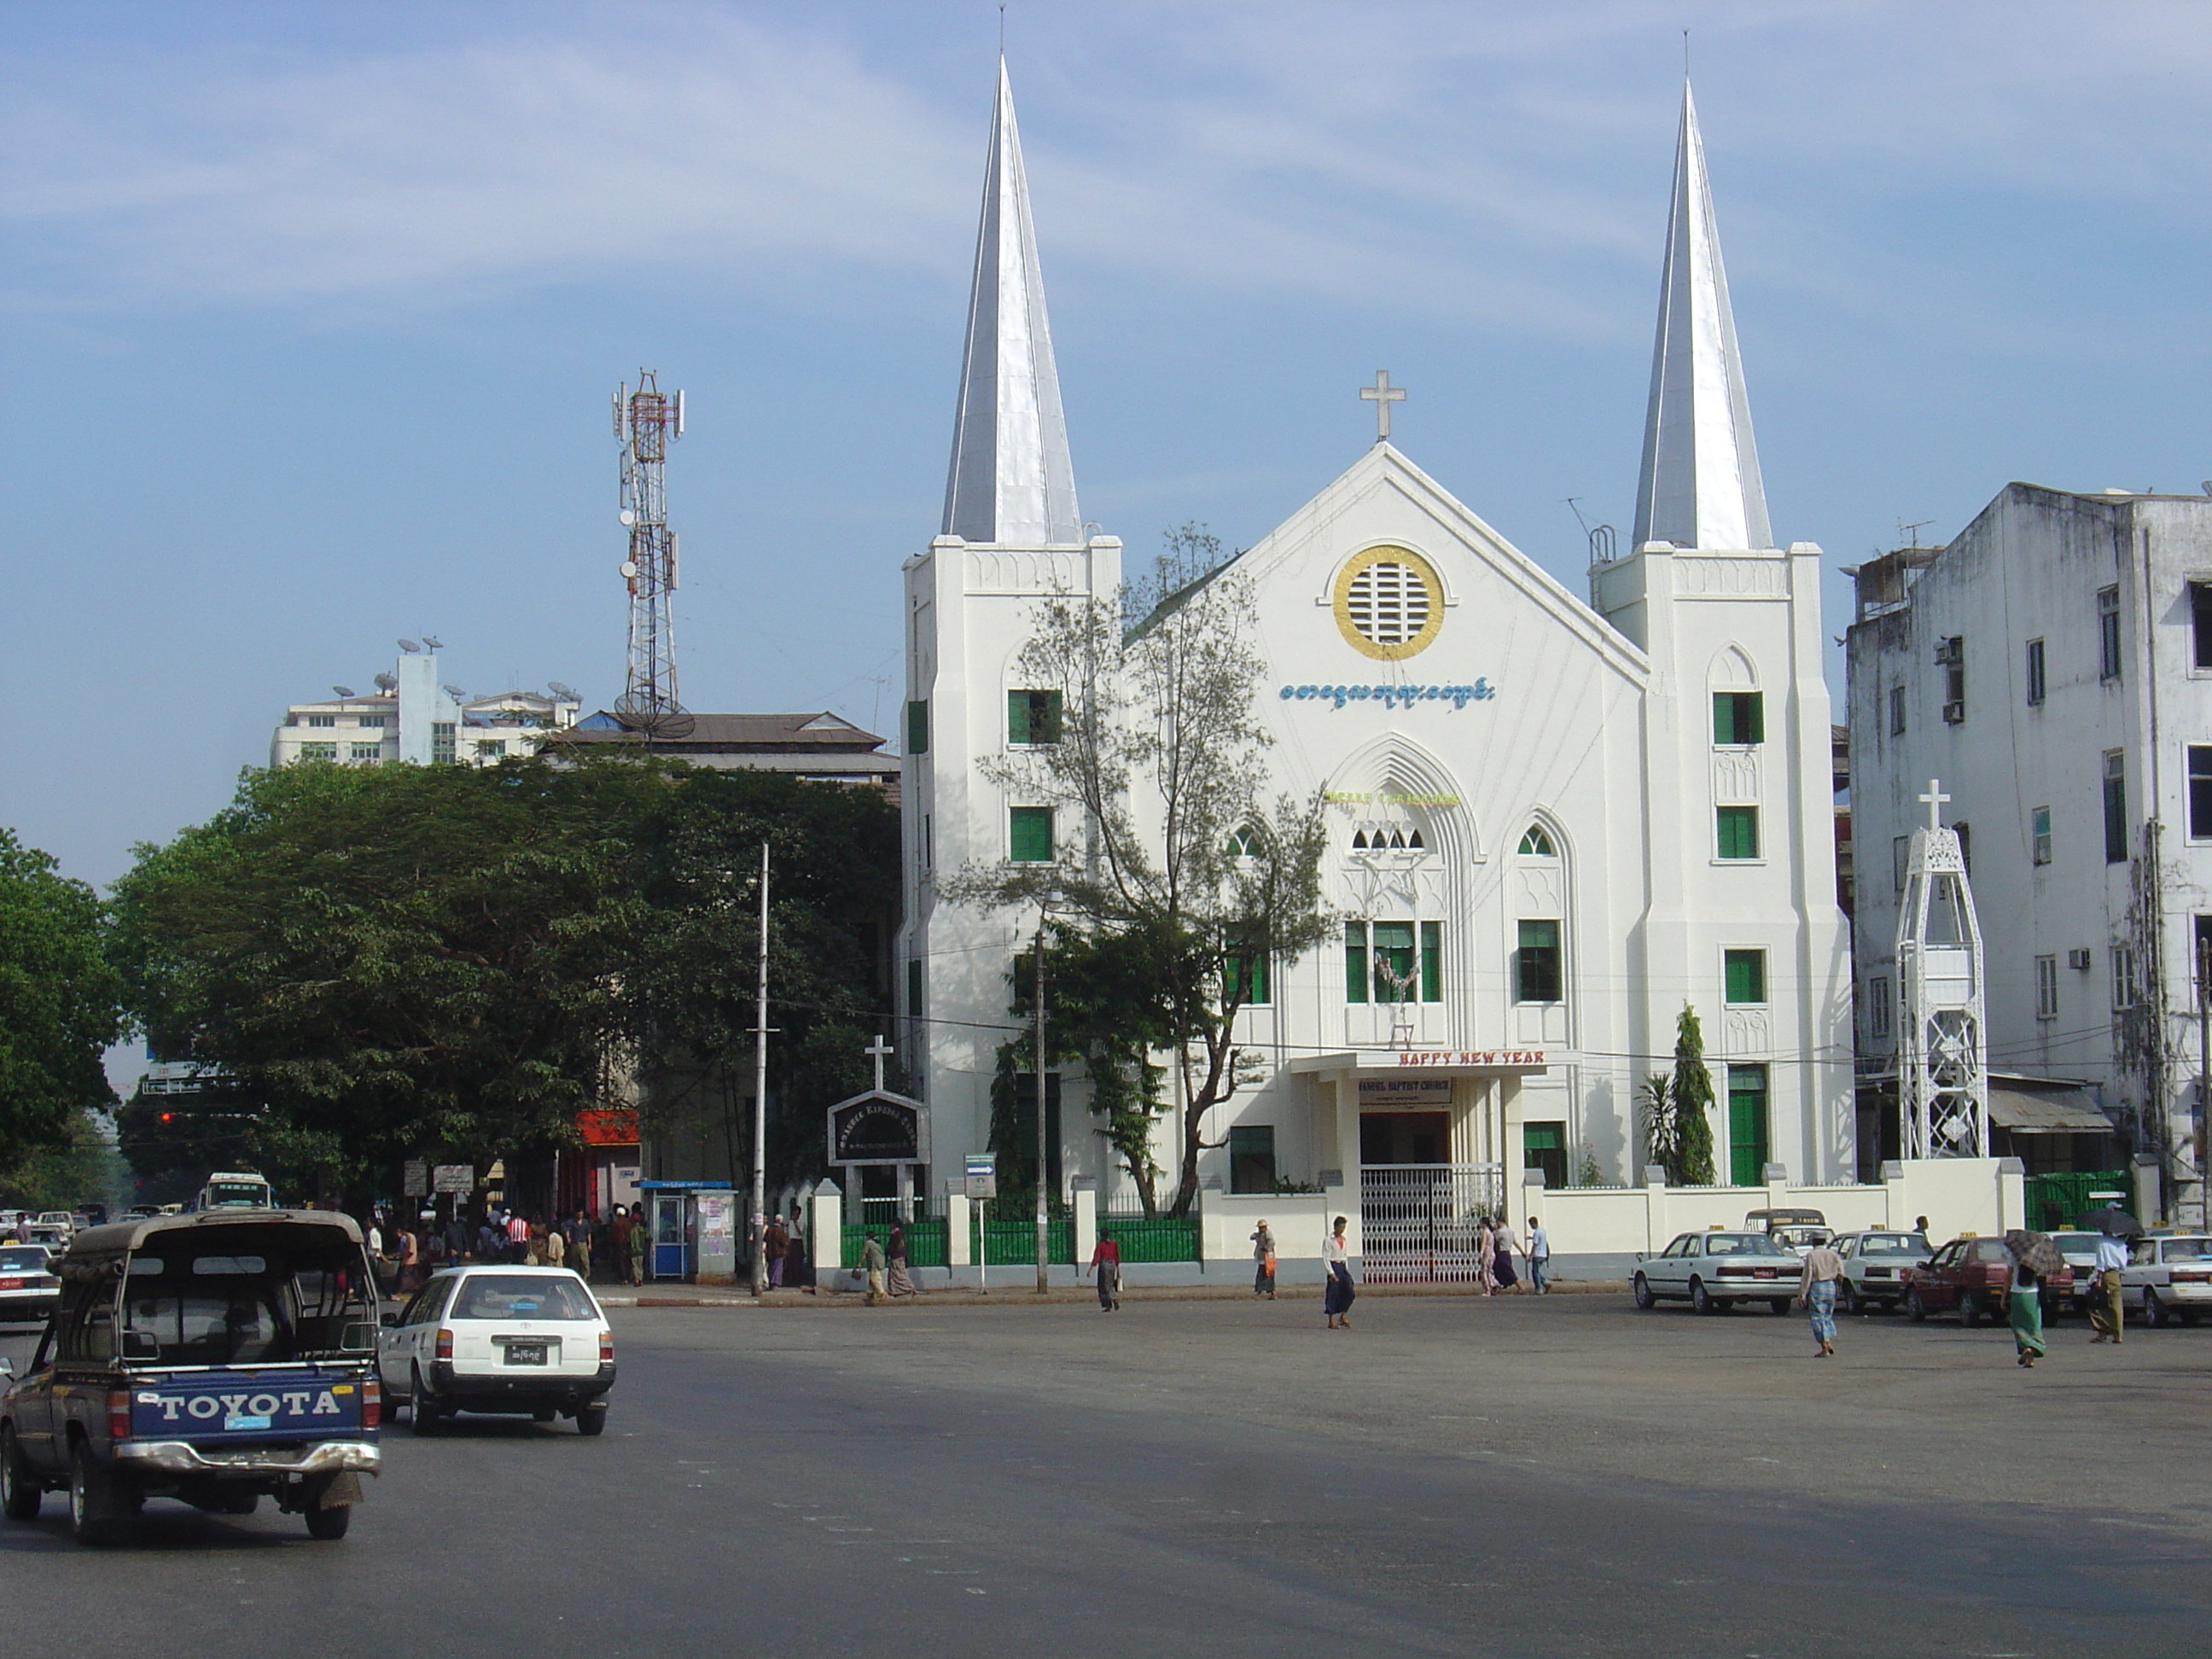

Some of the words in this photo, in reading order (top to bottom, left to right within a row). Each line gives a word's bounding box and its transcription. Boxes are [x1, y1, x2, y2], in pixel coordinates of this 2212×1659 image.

[1399, 1052, 1452, 1065] HAPPY
[1459, 1051, 1497, 1065] NEW
[1502, 1051, 1544, 1064] YEAR
[1388, 1080, 1418, 1091] BAPTIST
[1420, 1080, 1448, 1091] CHURCH
[157, 1391, 341, 1420] TOYOTA
